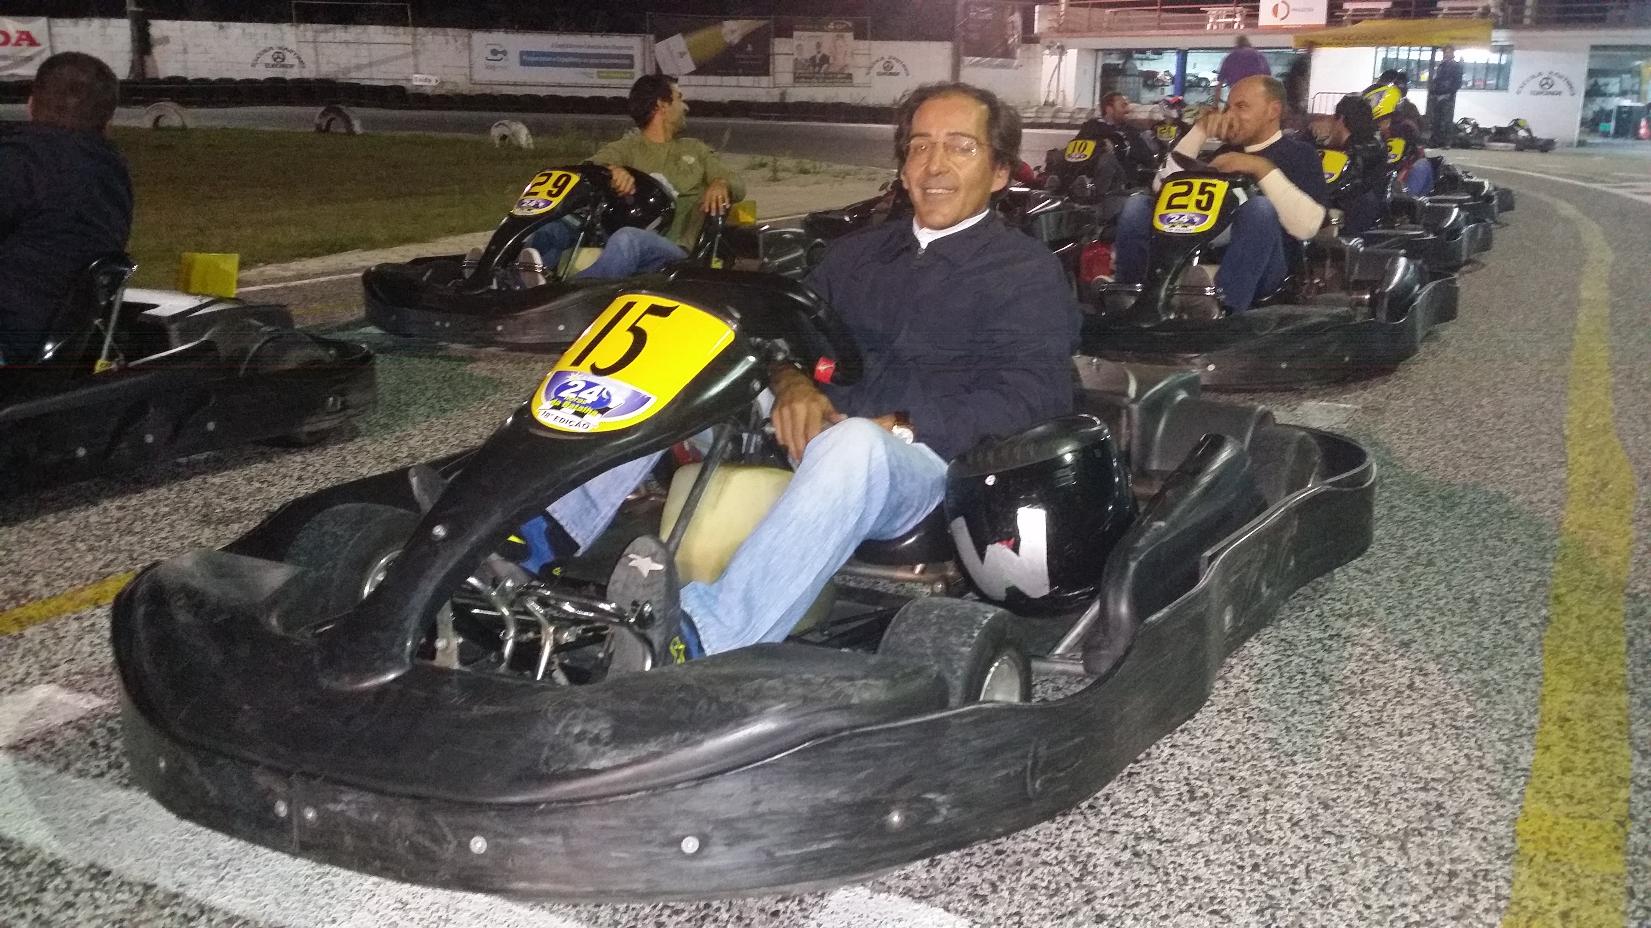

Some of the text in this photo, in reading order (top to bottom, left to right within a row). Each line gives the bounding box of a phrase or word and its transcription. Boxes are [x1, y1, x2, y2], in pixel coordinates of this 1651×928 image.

[1071, 141, 1088, 154] 10
[523, 172, 572, 198] 29
[1165, 181, 1217, 211] 25
[570, 301, 680, 377] 15
